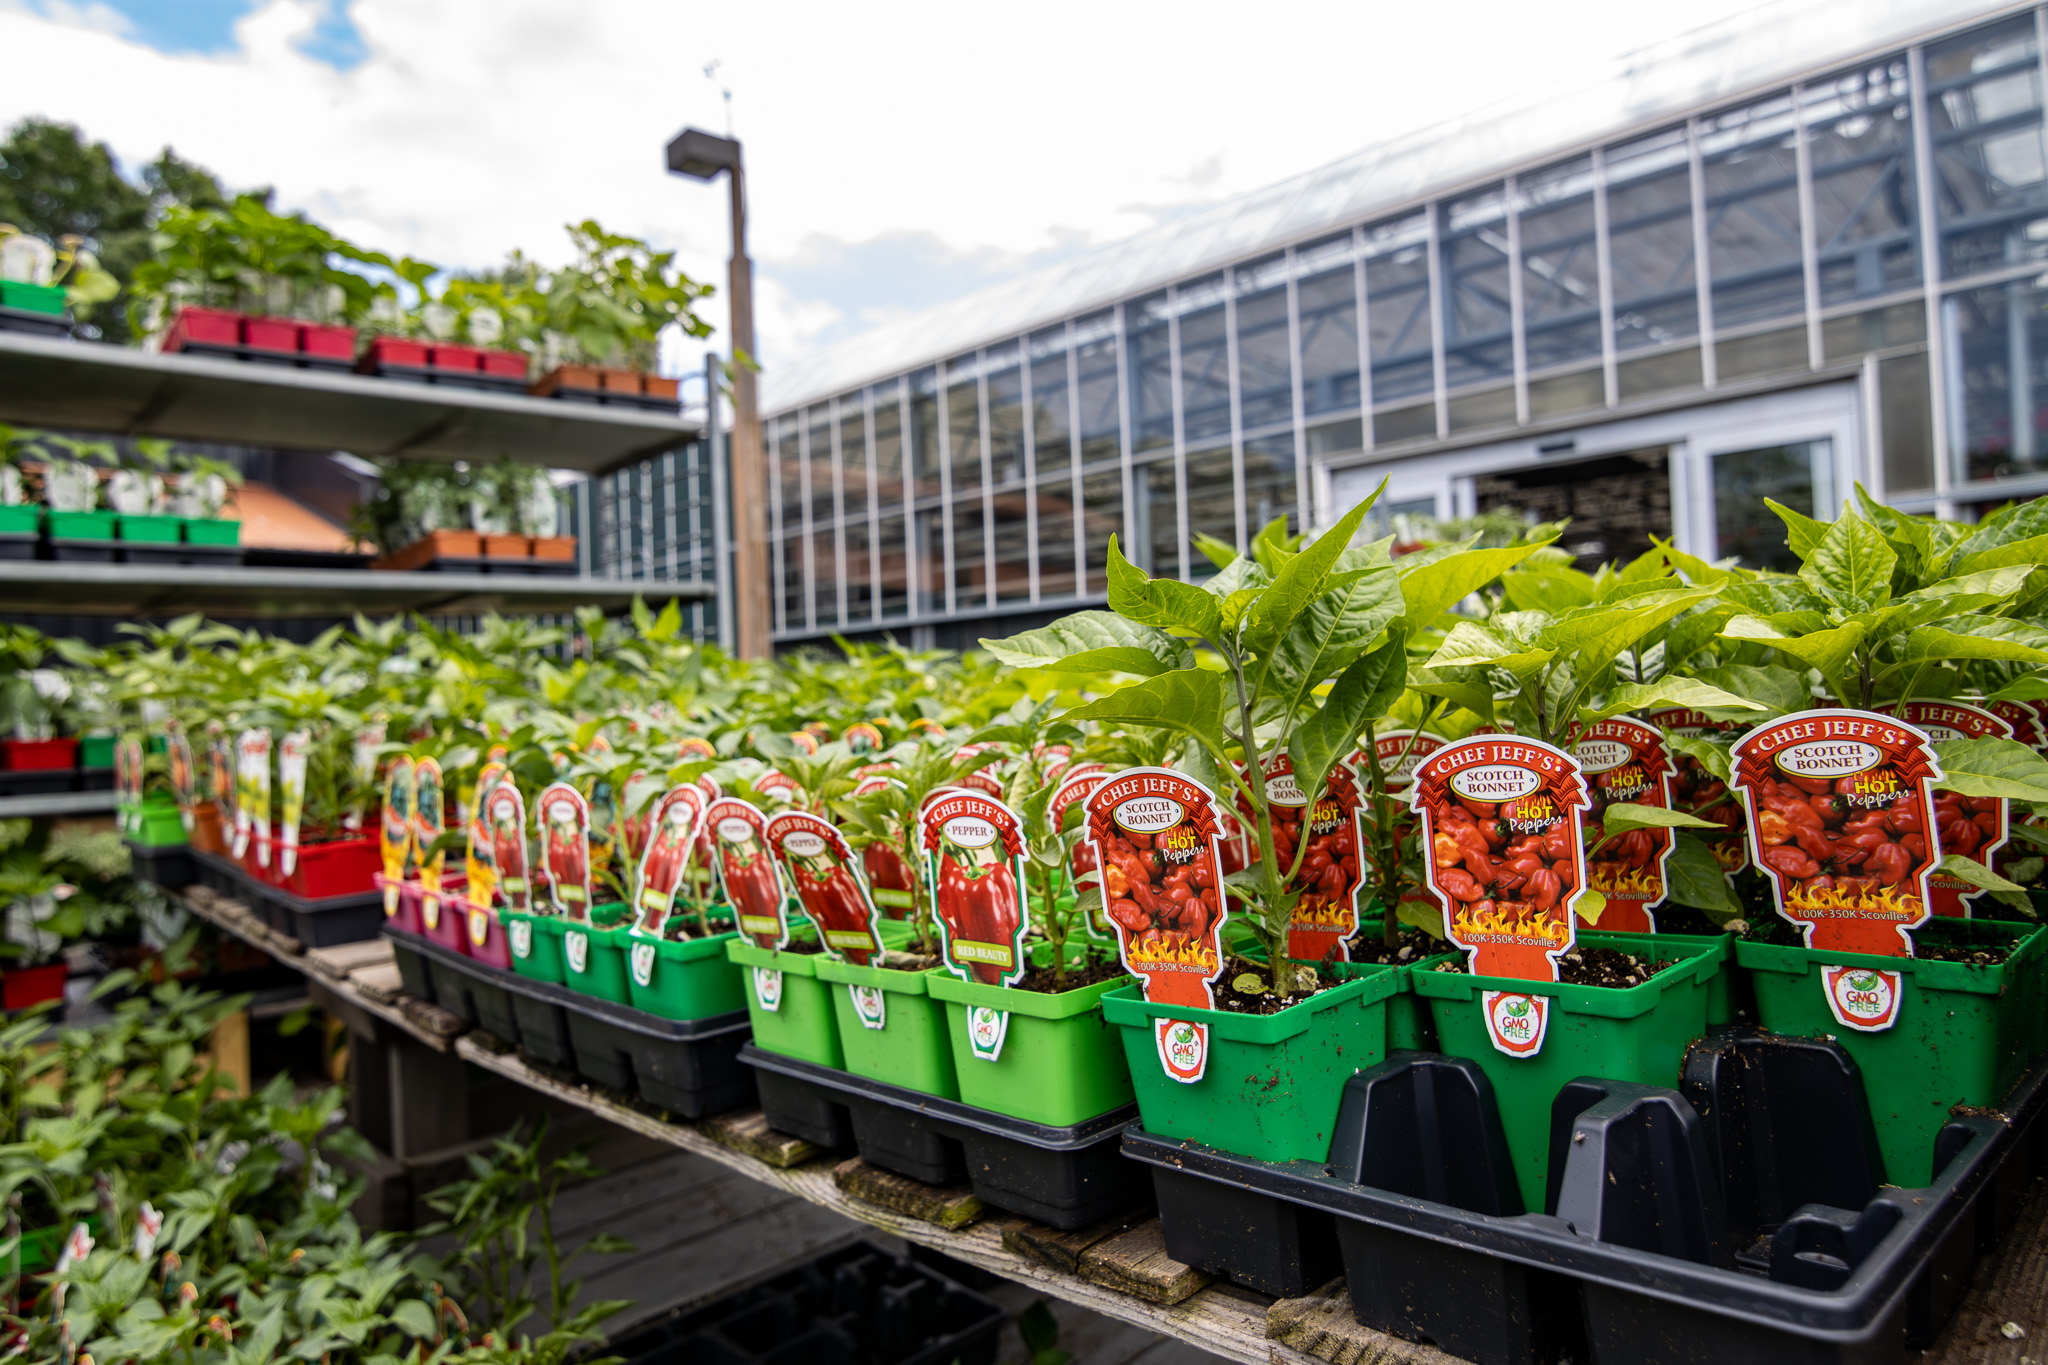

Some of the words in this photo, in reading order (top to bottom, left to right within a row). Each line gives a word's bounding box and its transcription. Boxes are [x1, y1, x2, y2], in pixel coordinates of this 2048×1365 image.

[1919, 707, 1985, 732] JEFF'S
[1588, 723, 1643, 743] JEFF'S
[1757, 722, 1816, 751] CHEF
[1822, 720, 1897, 745] JEFF'S
[1573, 744, 1617, 756] COTCH
[1794, 744, 1862, 758] SCOTCH
[1436, 746, 1486, 774] CHEF
[1491, 745, 1554, 771] JEFF'S
[1579, 754, 1618, 766] ONNET
[1796, 756, 1863, 770] BONNET
[1466, 770, 1524, 782] SCOTCH
[1272, 779, 1295, 790] SCO
[1467, 781, 1525, 793] BONNET
[1605, 781, 1654, 801] Peppers
[1059, 782, 1087, 807] CHEF
[1101, 779, 1139, 806] CHEF
[1142, 778, 1193, 801] JEFF'S
[1274, 789, 1307, 799] BONN
[1846, 789, 1910, 809] Peppers
[933, 800, 963, 822] CHEF
[966, 800, 1004, 825] JEFF'S
[1125, 802, 1171, 813] SCOTCH
[1127, 812, 1172, 825] BONNET
[1311, 816, 1347, 835] eppers
[1509, 815, 1563, 835] Peppers
[951, 825, 988, 837] PEPPER
[1162, 845, 1205, 865] Peppers
[1927, 878, 1973, 891] Scovilles
[1797, 909, 1858, 919] 100K-350K
[1859, 909, 1910, 921] Scovilles
[1463, 933, 1515, 945] 100K-350K
[1516, 935, 1558, 948] Scovilles
[956, 945, 976, 957] RED
[976, 946, 1009, 962] BEAUTY
[1136, 962, 1178, 973] 100K-350K
[1179, 963, 1211, 975] Scovilles
[1846, 990, 1879, 1004] GMO
[1848, 1001, 1881, 1013] FREE
[1502, 1016, 1529, 1030] GMO
[1503, 1027, 1530, 1039] FREE
[1172, 1043, 1194, 1056] GMO
[1173, 1054, 1195, 1065] FREE
